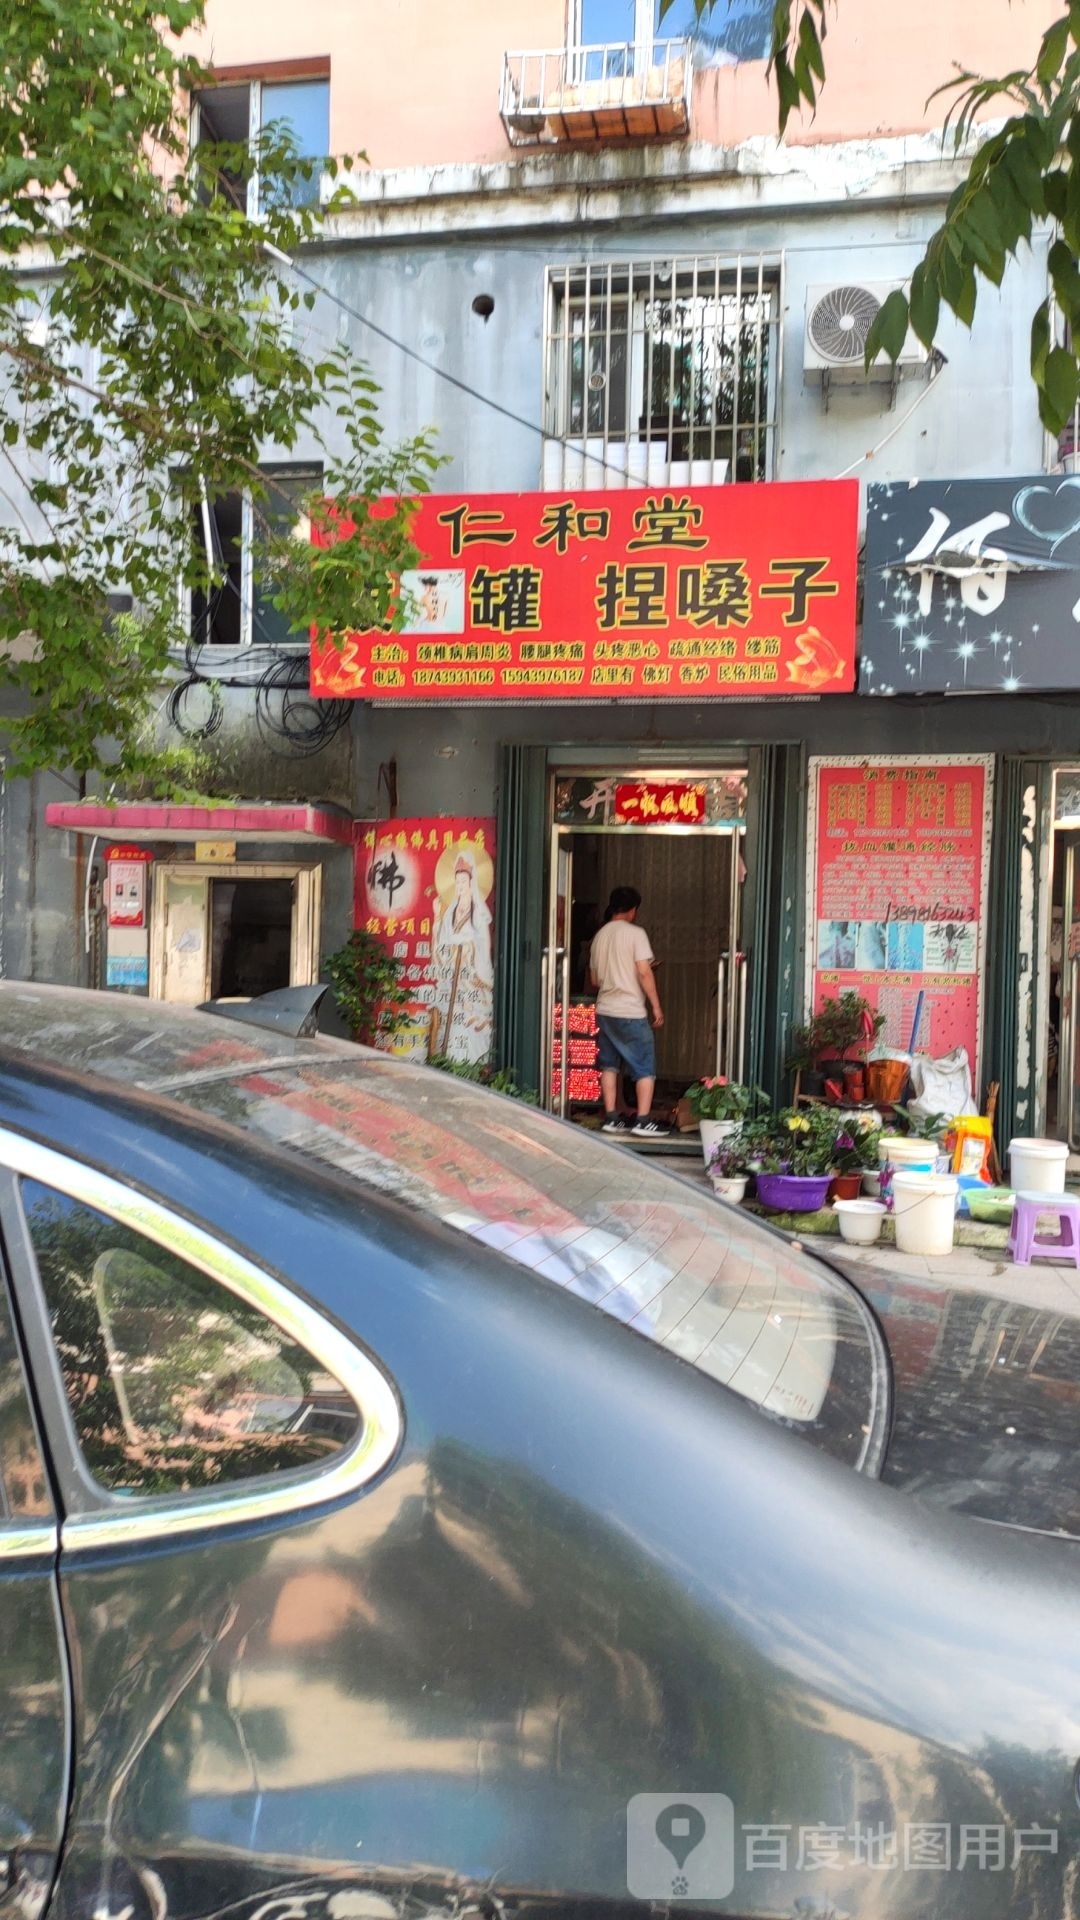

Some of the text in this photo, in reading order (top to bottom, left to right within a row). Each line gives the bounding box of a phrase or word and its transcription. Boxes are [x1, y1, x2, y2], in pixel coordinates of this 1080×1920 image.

[438, 493, 709, 557] 仁和堂
[470, 564, 541, 632] 罐
[597, 556, 839, 629] 捏嗓子
[416, 643, 511, 662] 颈椎病肩周炎
[519, 642, 585, 660] 腰腿疼痛
[594, 640, 660, 660] 头疼恶心
[668, 637, 737, 658] 疏通经络
[591, 665, 635, 684] 店里有
[680, 663, 710, 684] 香炉
[717, 661, 778, 682] 民俗用品
[366, 917, 430, 936] 经营项目
